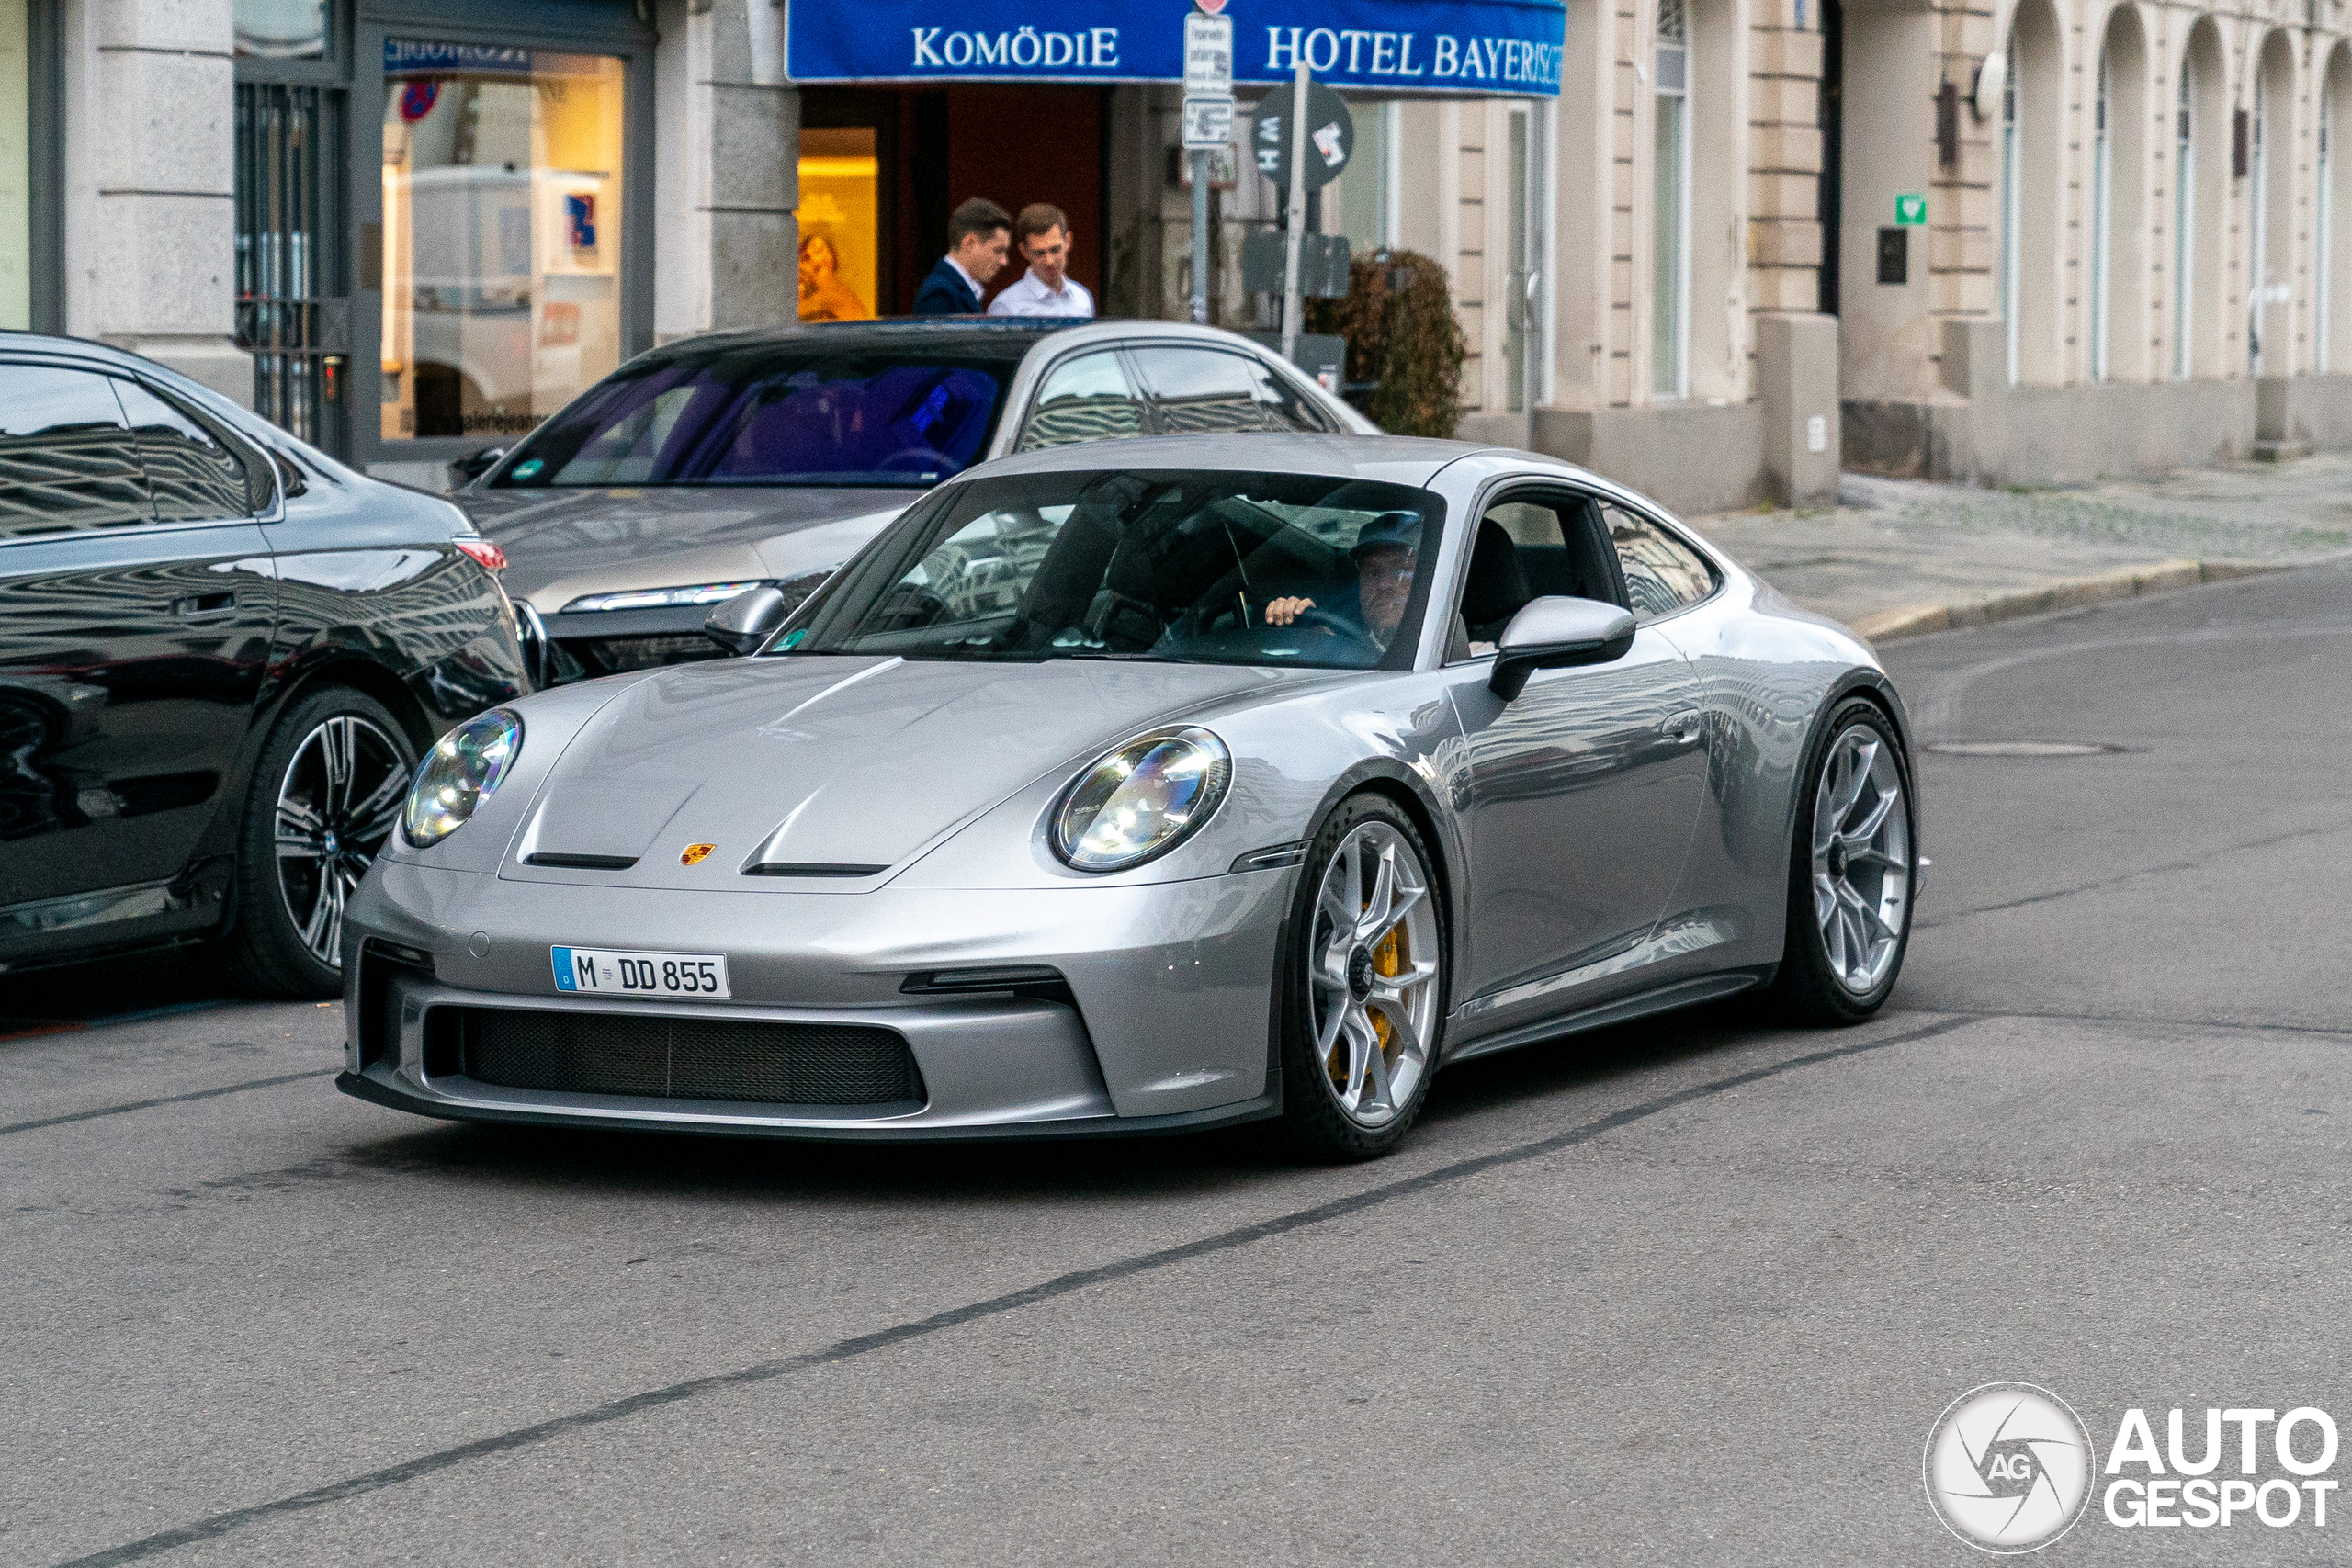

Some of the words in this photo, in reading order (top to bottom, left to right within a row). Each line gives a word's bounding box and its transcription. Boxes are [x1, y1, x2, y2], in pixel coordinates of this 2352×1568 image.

[910, 25, 1119, 67] KOMÖDIE
[1265, 26, 1422, 75] HOTEL
[577, 956, 597, 987] M
[618, 958, 657, 990] DD
[662, 961, 718, 993] 855
